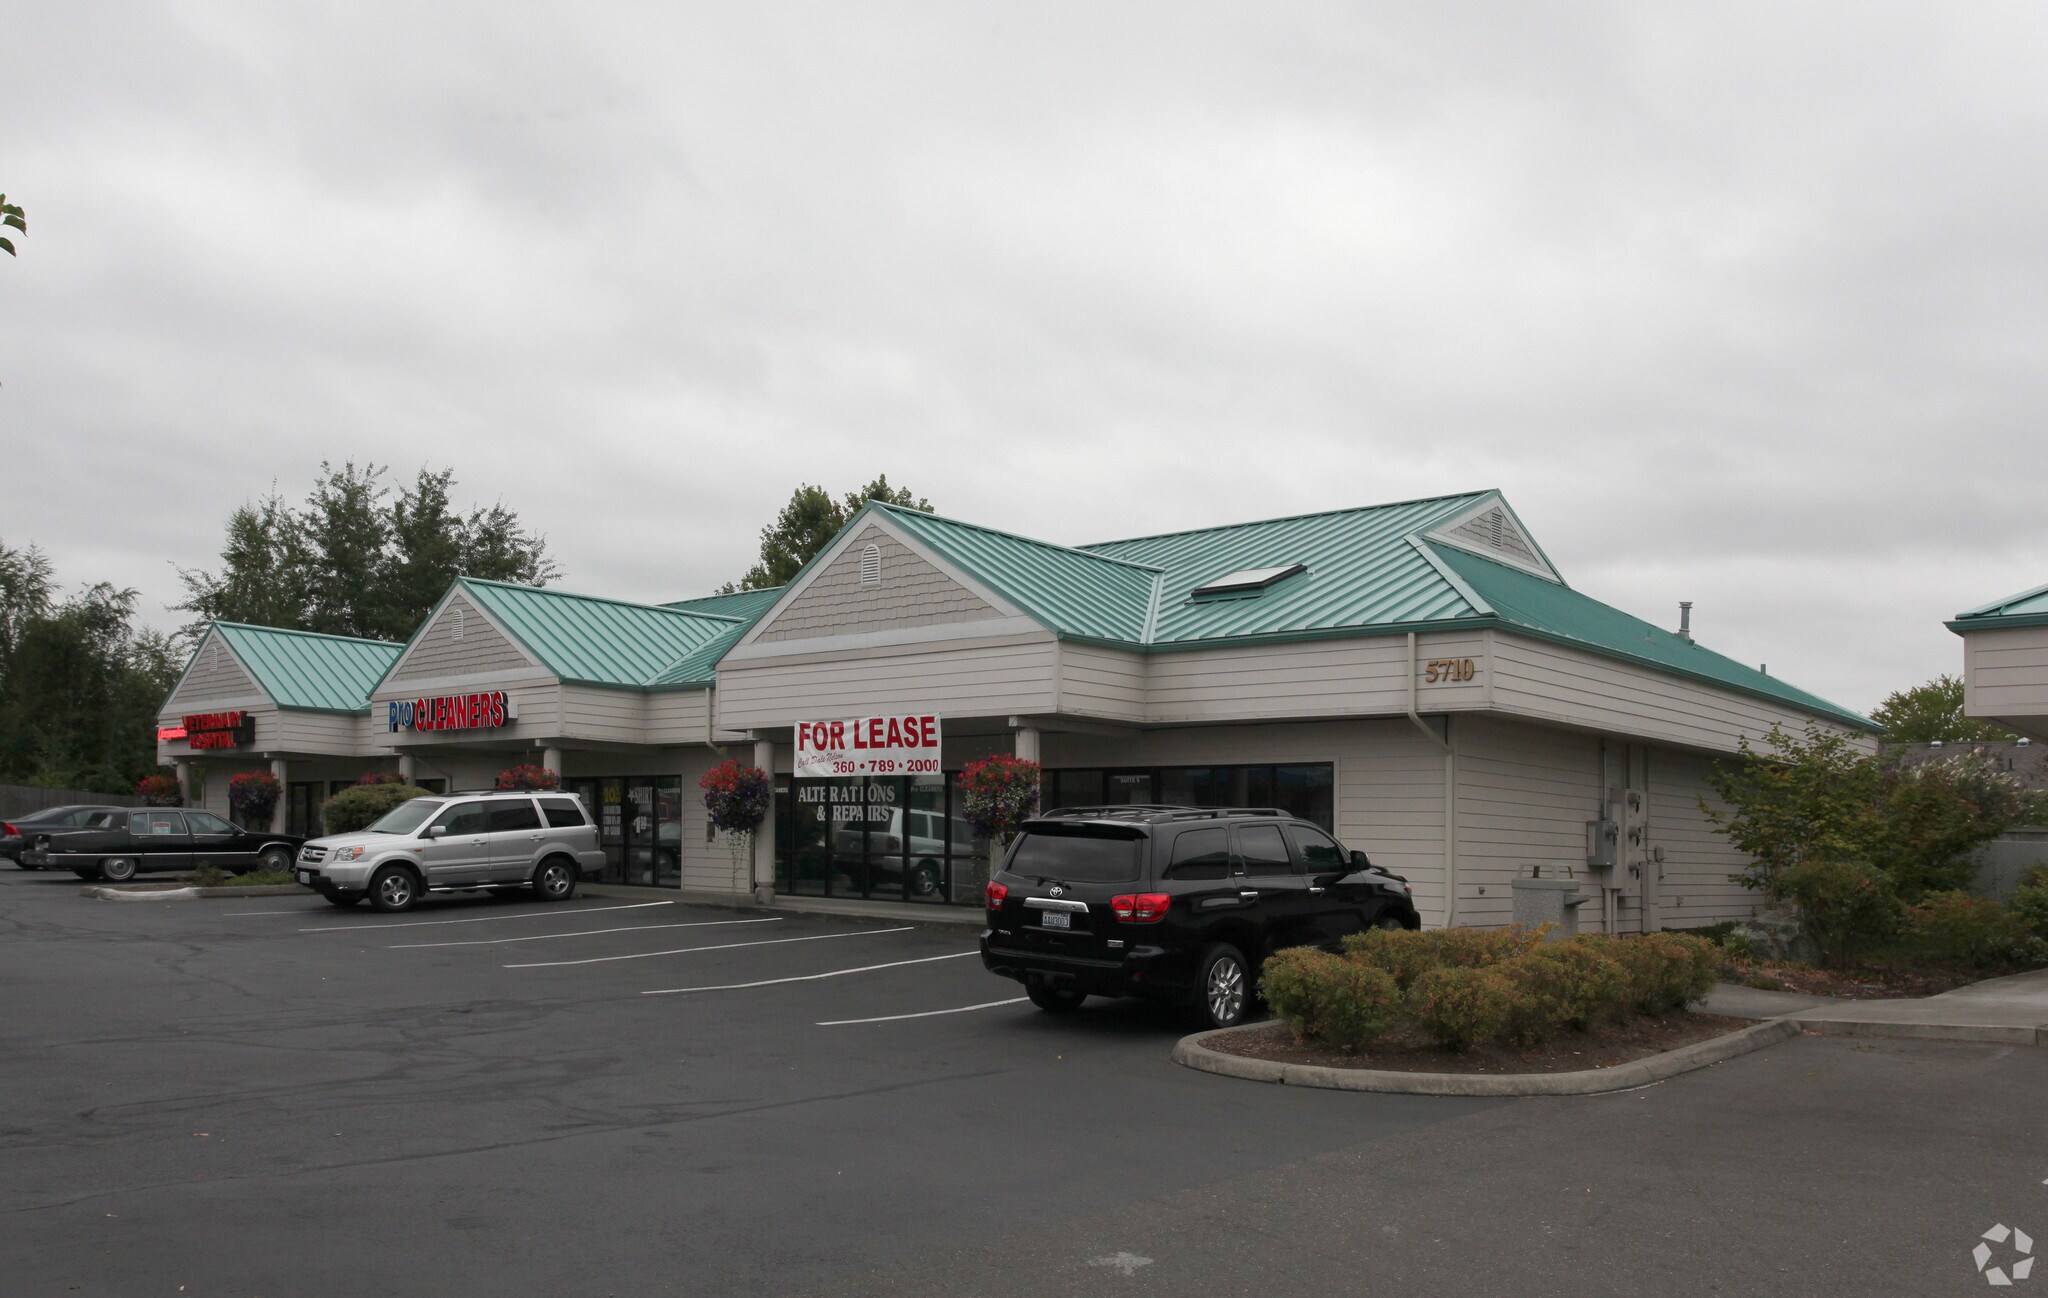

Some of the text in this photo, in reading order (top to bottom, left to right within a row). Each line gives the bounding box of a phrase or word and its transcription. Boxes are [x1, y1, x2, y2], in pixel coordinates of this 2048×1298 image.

[1425, 659, 1474, 683] 5710
[182, 711, 241, 731] VETERINARY
[415, 691, 504, 732] CLEANERS
[189, 731, 236, 749] HOSPITAL
[798, 716, 938, 751] FOR LEASE
[833, 759, 938, 773] 360 789 2000
[635, 787, 653, 804] SHIRT
[816, 805, 890, 821] & REPAIRS
